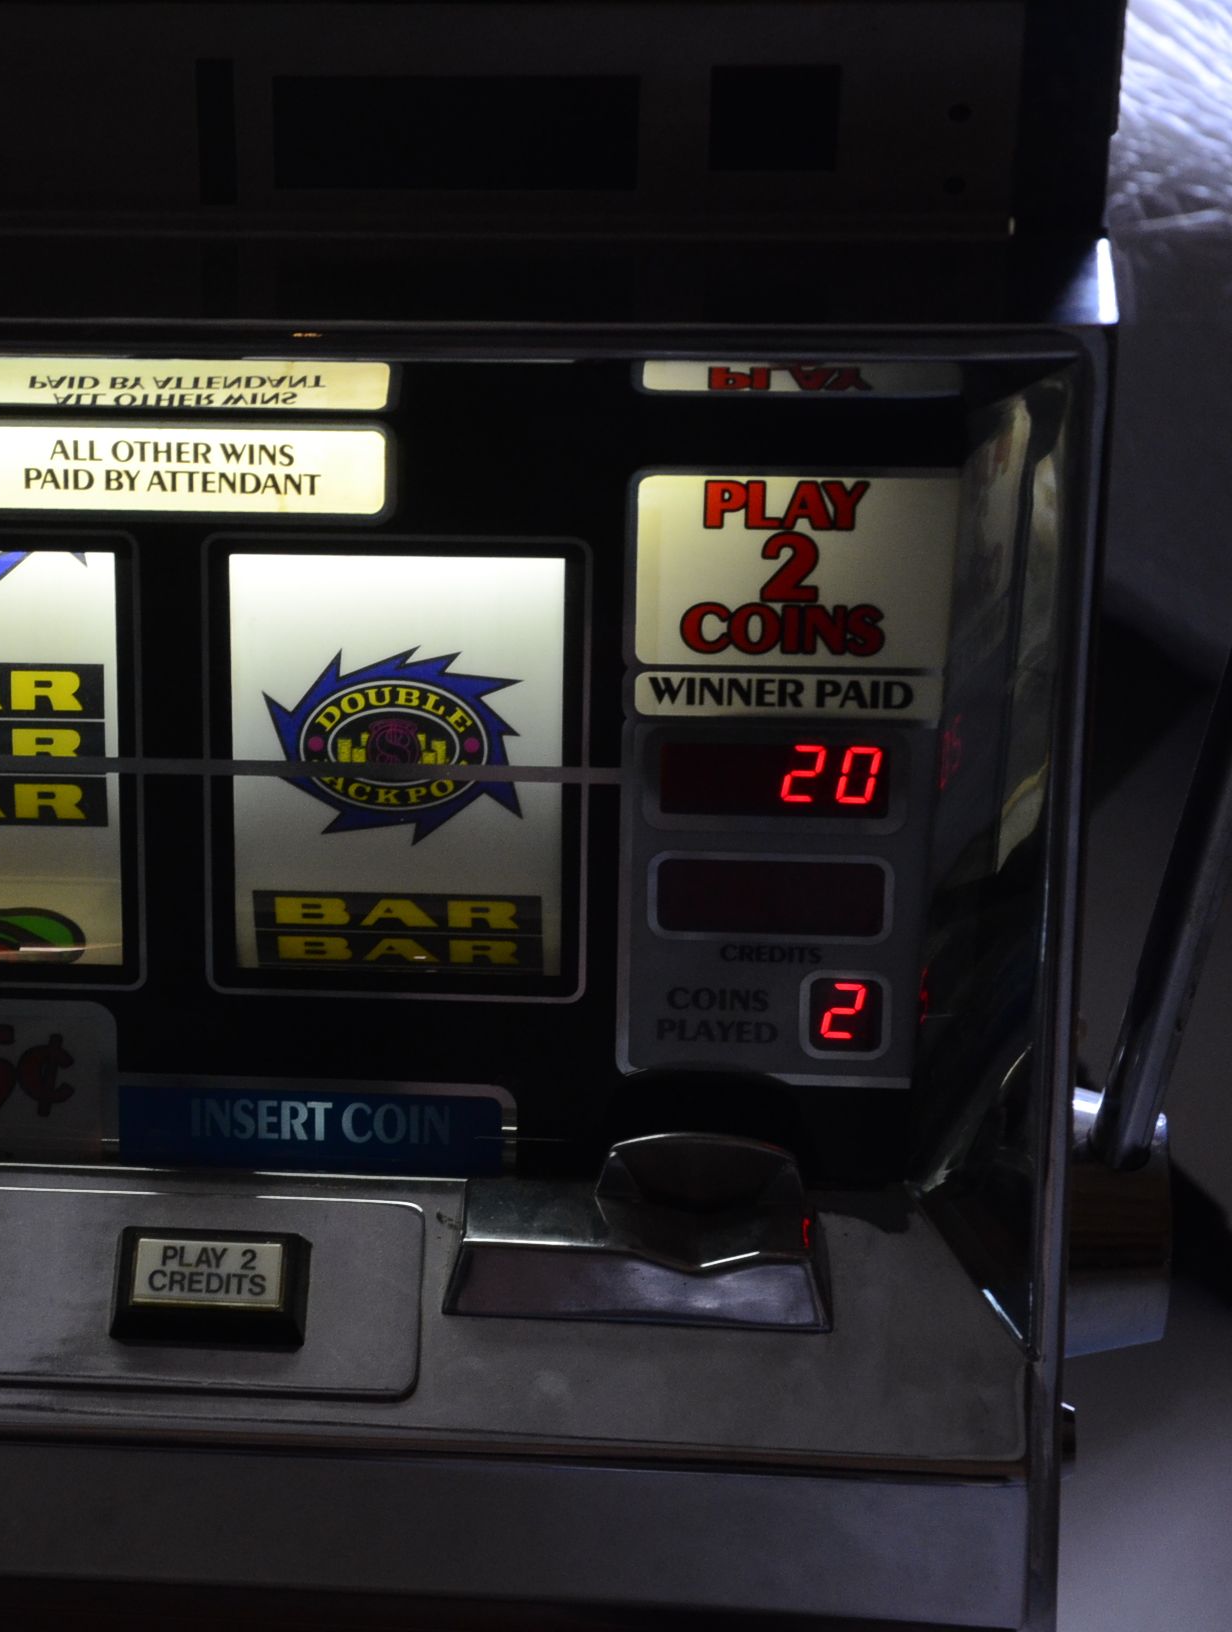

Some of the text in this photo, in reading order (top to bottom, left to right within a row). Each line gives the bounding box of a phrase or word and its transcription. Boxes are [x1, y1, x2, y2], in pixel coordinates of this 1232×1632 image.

[50, 439, 294, 467] ALL OTHER WINS
[24, 467, 321, 496] PAID BY ATTENDANT
[703, 479, 871, 531] PLAY
[760, 530, 819, 603] 2
[680, 602, 886, 657] COINS
[314, 685, 474, 734] DOUBLE
[648, 677, 914, 710] WINNER PAID
[312, 759, 470, 806] ACKPO
[780, 744, 885, 805] 20
[274, 896, 518, 929] BAR
[277, 935, 519, 965] BAR
[719, 944, 823, 964] CREDITS
[667, 986, 770, 1012] COINS
[820, 981, 868, 1040] 2
[656, 1019, 778, 1044] PLAYED
[191, 1098, 451, 1145] INSERT COIN
[161, 1246, 257, 1271] PLAY 2
[148, 1269, 267, 1296] CREDITS
